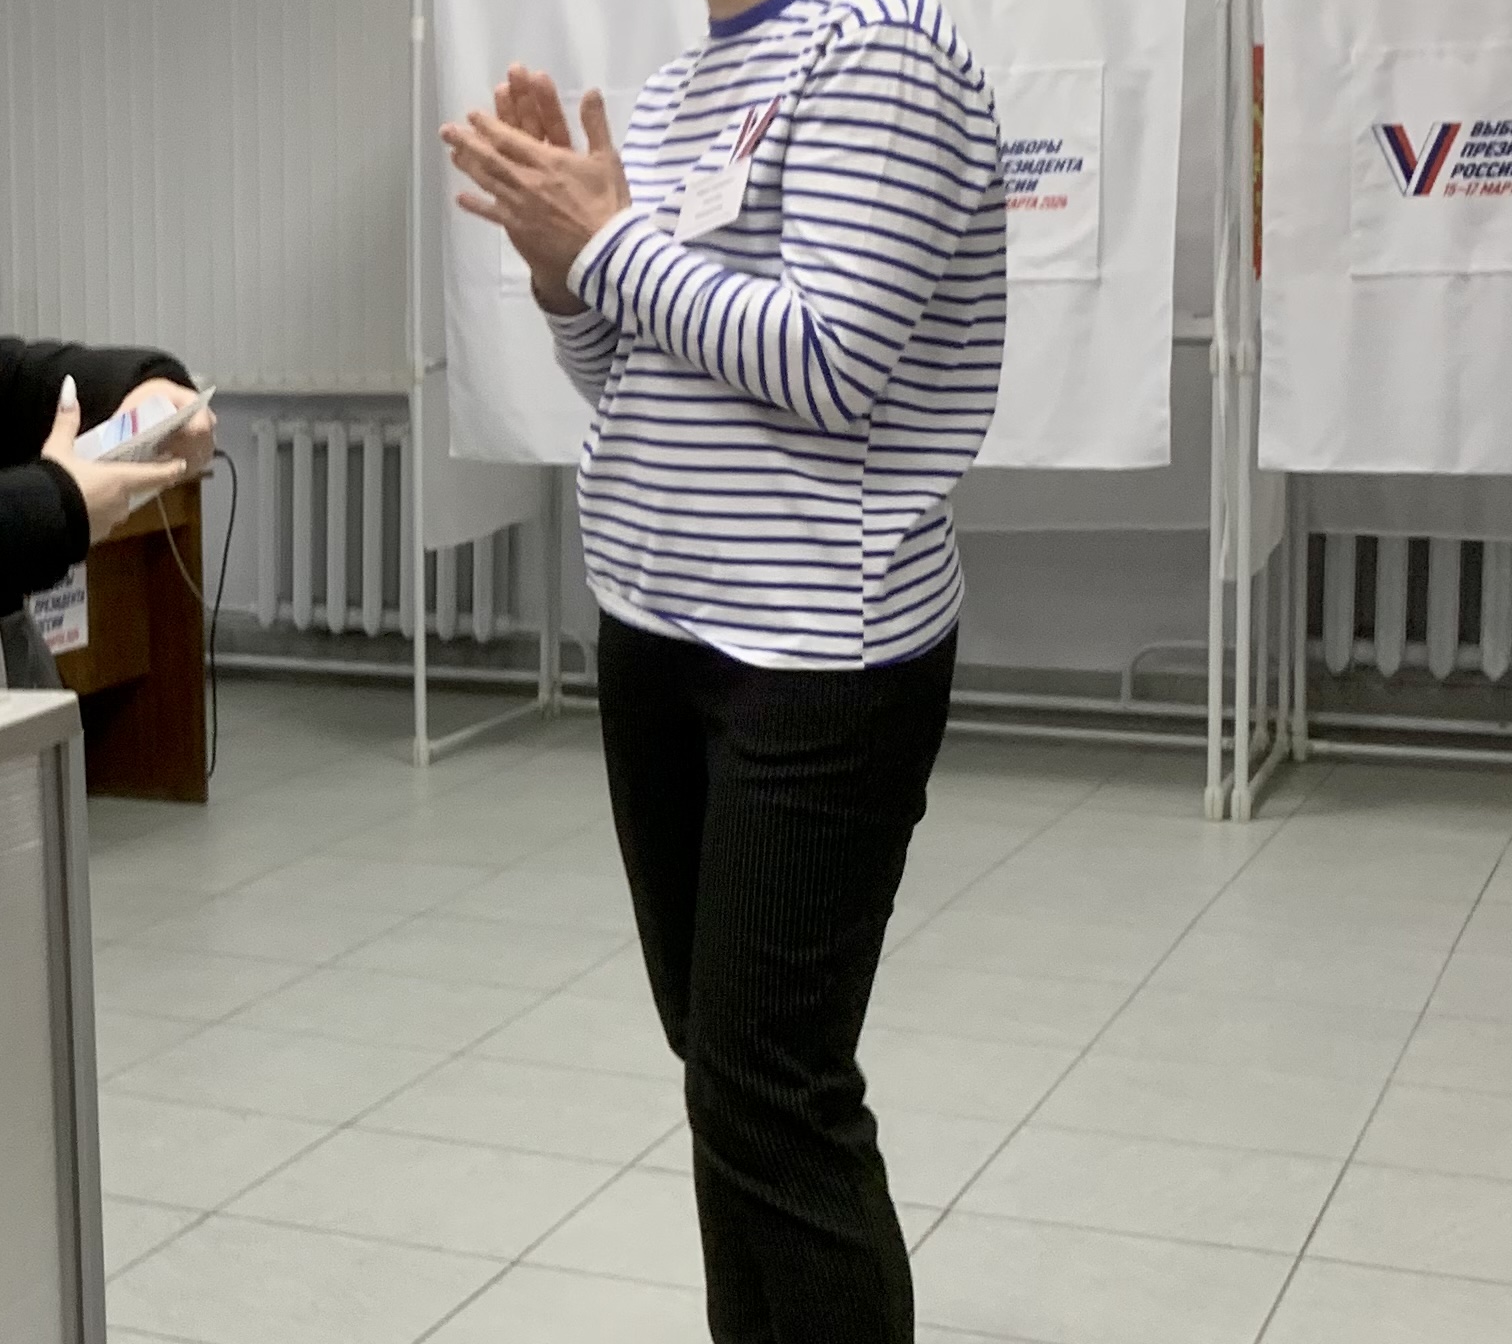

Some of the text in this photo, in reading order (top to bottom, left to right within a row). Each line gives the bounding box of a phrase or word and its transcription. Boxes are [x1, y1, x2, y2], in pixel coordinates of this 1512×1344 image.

[1470, 120, 1512, 137] ВЫБ
[1001, 139, 1063, 154] ЫБОРЫ
[1003, 158, 1083, 175] ЕЗИДЕНТА
[1450, 162, 1512, 179] РОССИ
[1005, 179, 1039, 192] СИИ
[1480, 182, 1512, 196] МАР
